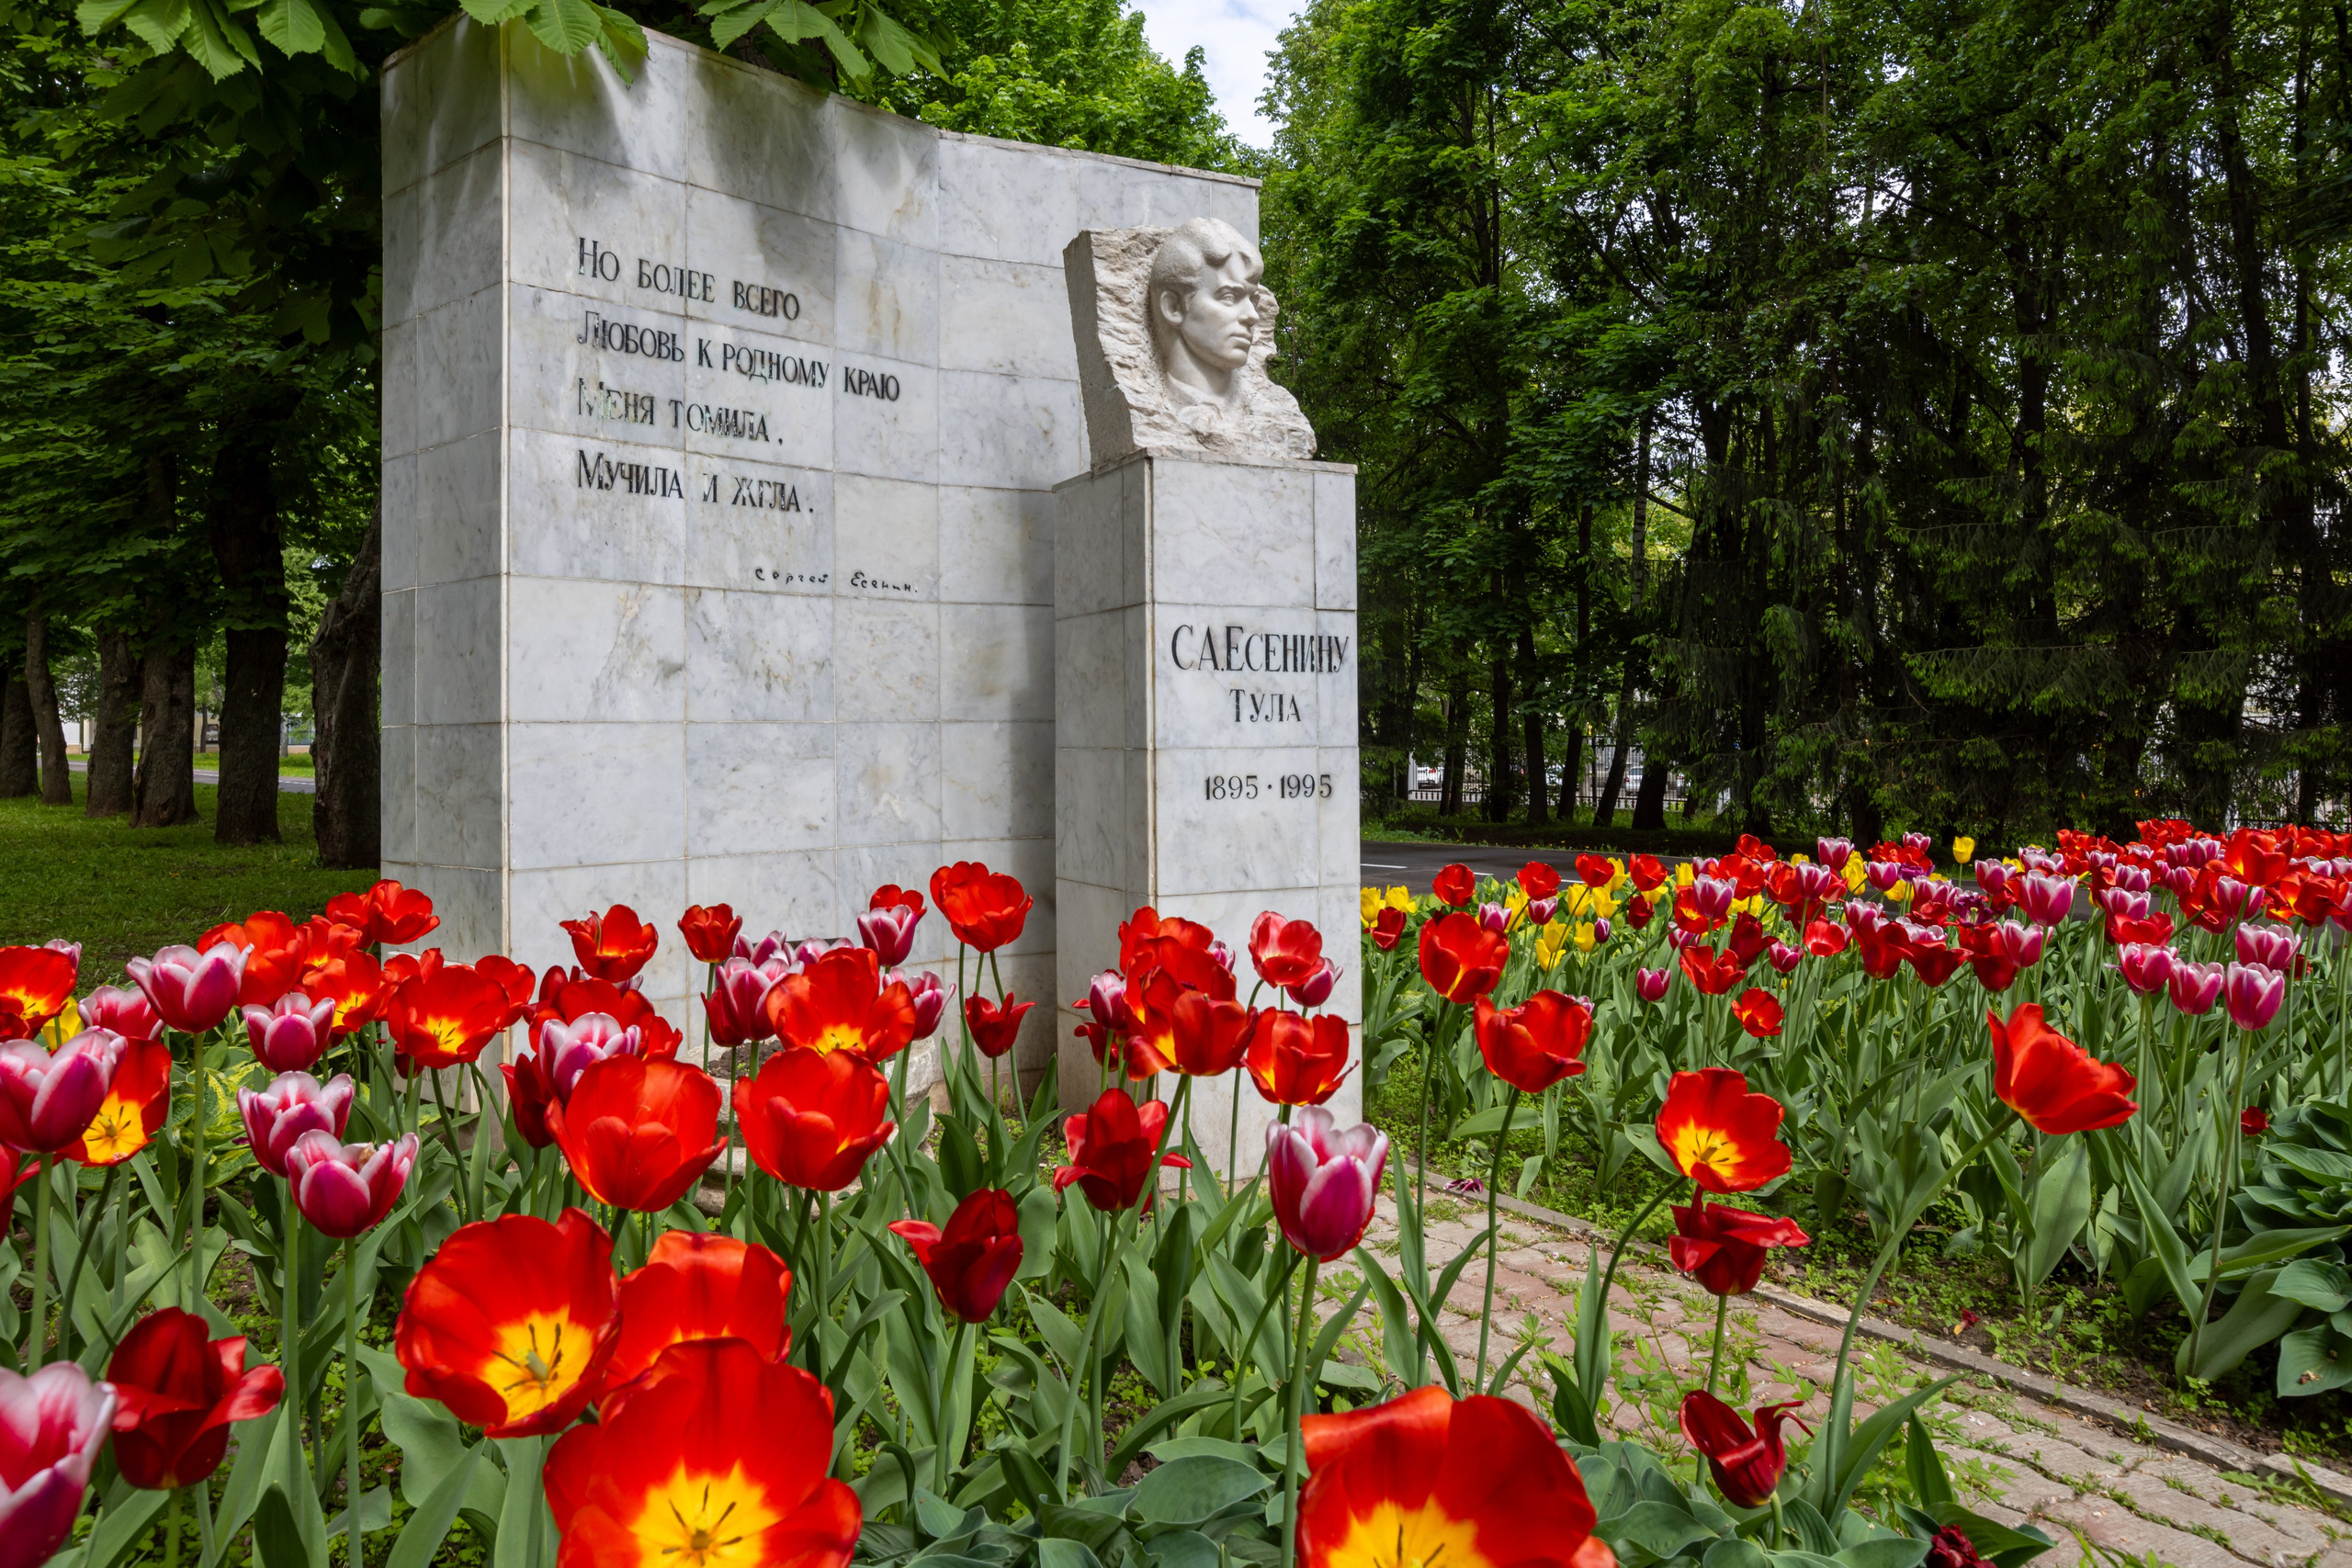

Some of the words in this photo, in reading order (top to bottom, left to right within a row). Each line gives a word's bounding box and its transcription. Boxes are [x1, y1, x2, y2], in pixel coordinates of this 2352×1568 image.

[638, 258, 717, 303] БОЛЕЕ
[733, 280, 800, 321] ВСЕГО
[697, 337, 714, 368] К
[722, 342, 830, 388] РОДНОМУ
[843, 366, 900, 401] КРАЮ
[702, 473, 718, 503] И
